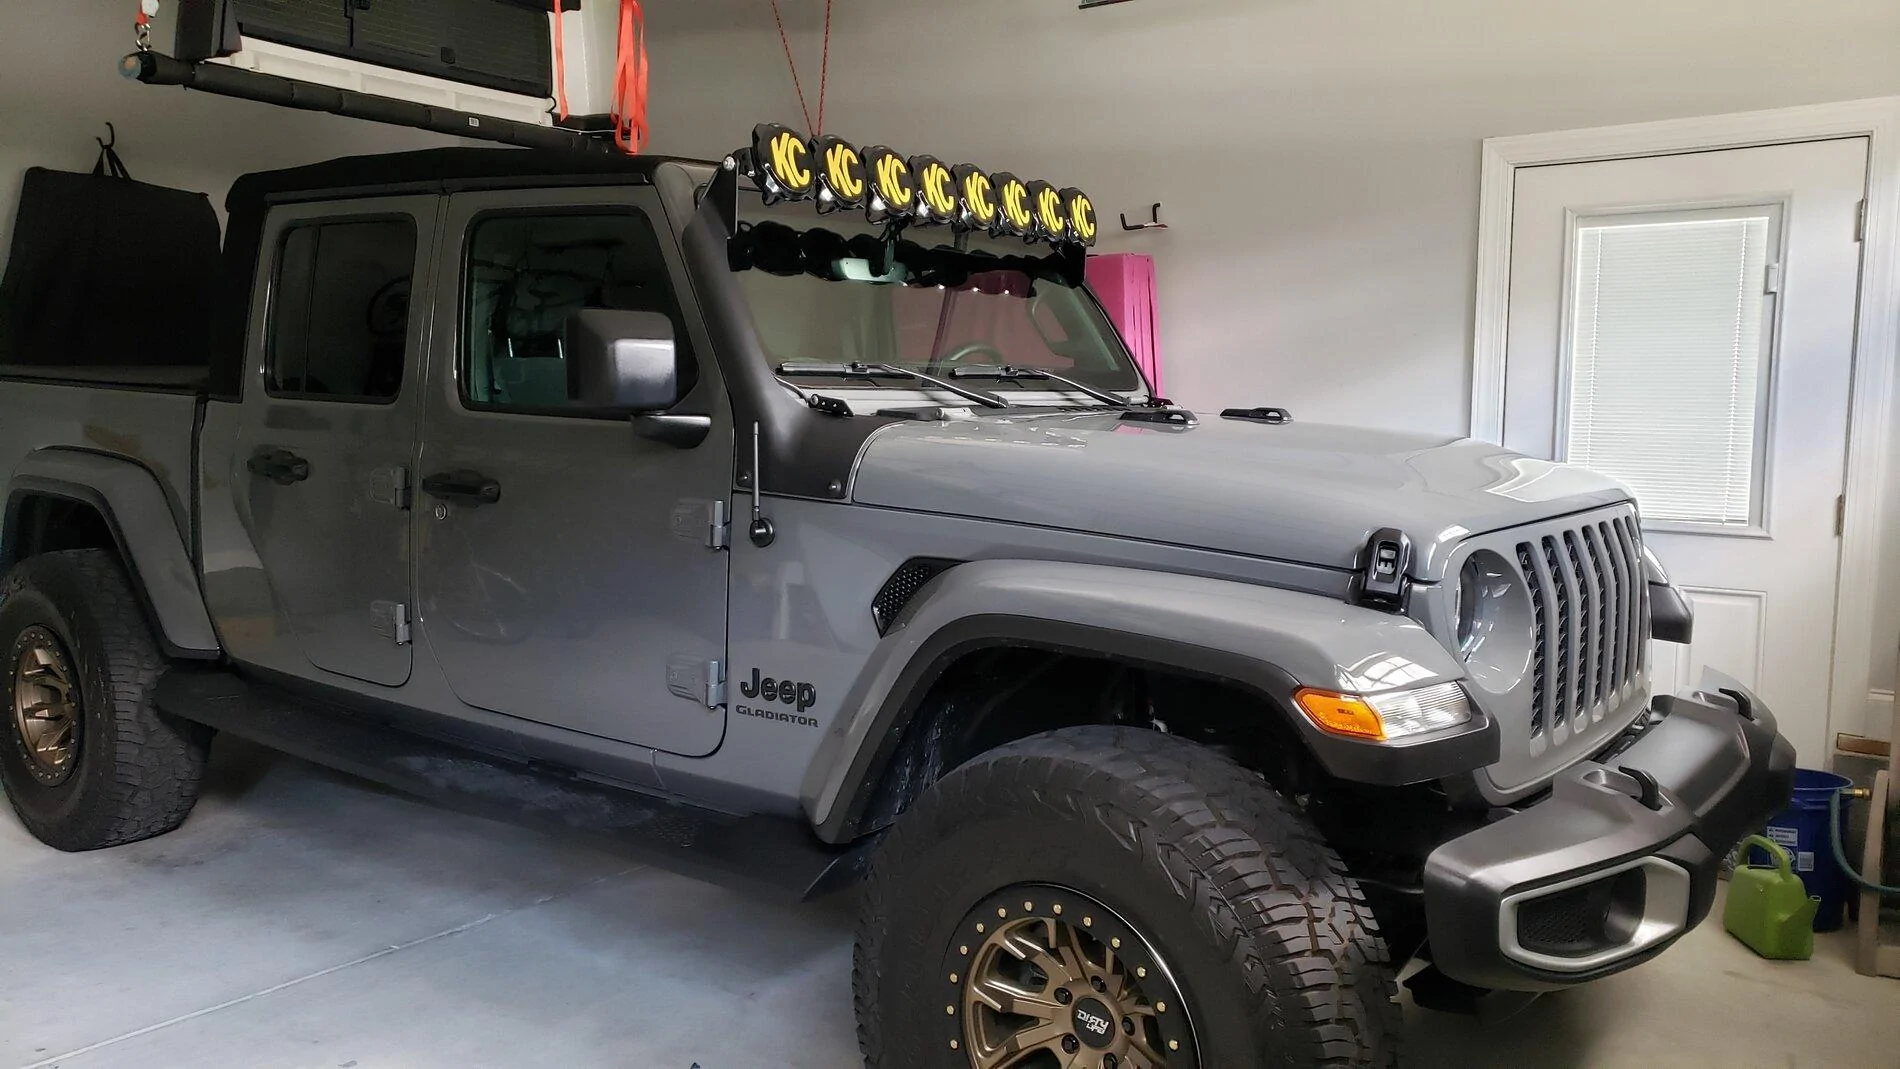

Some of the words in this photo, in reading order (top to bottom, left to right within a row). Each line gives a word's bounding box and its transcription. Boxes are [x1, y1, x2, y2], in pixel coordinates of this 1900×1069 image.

[771, 133, 810, 188] KC
[827, 144, 862, 197] KC
[877, 154, 911, 205] KC
[923, 164, 954, 214] KC
[966, 172, 995, 220] KC
[1004, 180, 1031, 227] KC
[1039, 188, 1064, 232] KC
[1072, 195, 1095, 238] KC
[740, 667, 817, 713] Jeep
[735, 704, 819, 728] GLADIATOR
